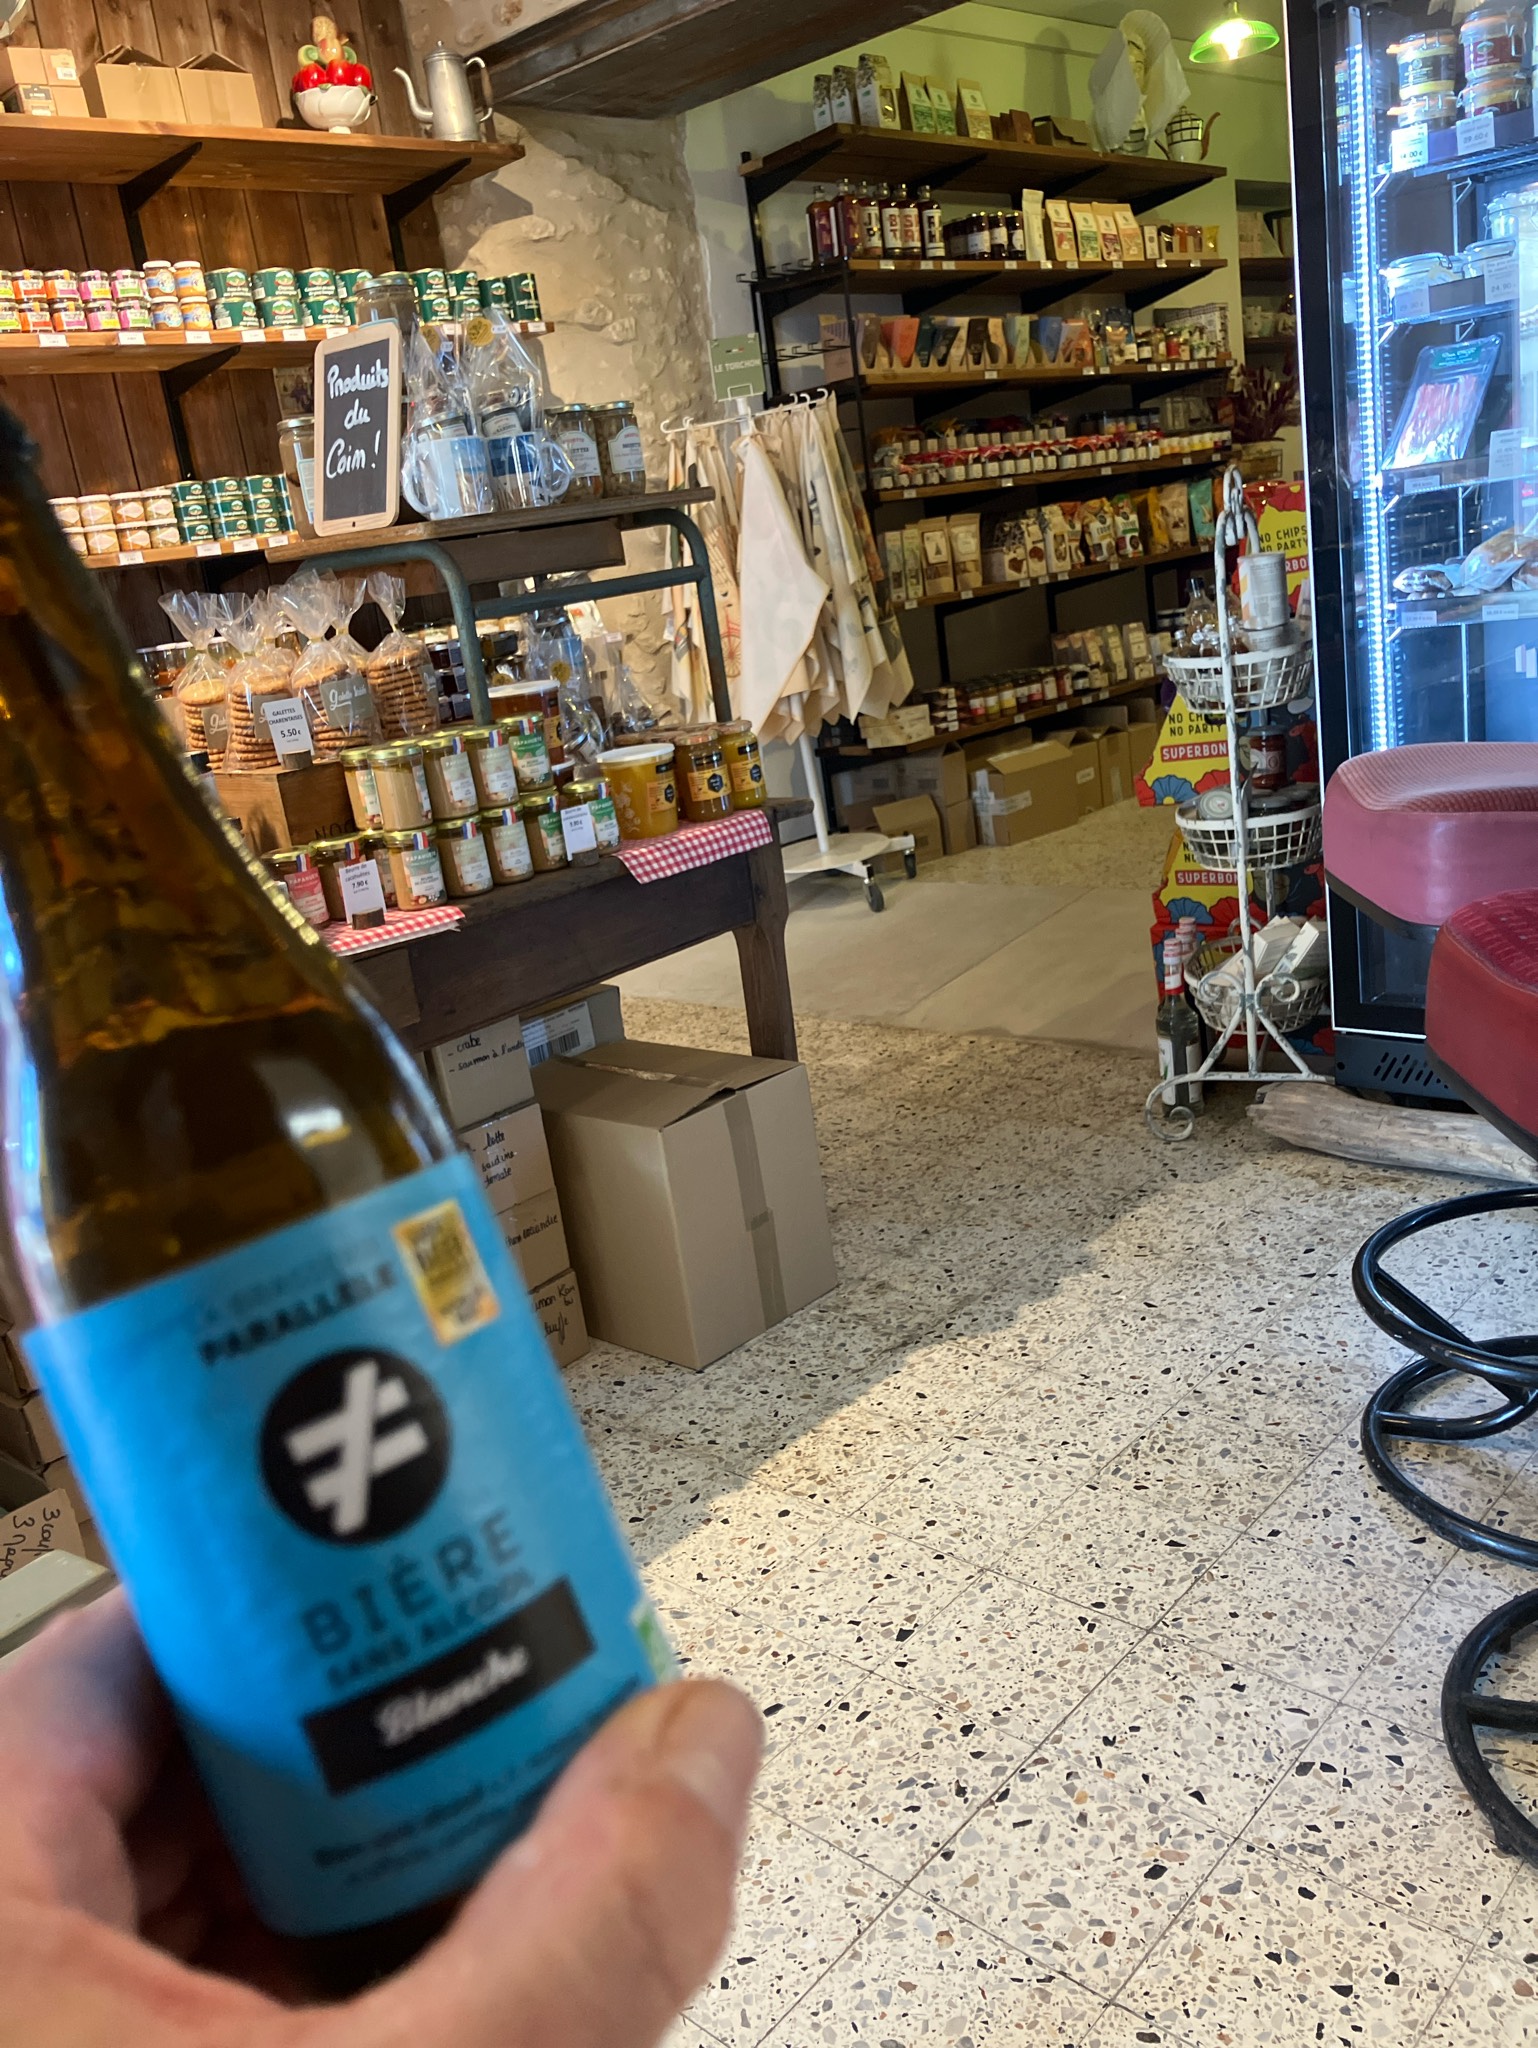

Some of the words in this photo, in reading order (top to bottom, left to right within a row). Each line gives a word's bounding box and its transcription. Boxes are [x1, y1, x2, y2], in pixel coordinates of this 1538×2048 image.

[714, 363, 723, 373] LE
[326, 358, 389, 399] Produits
[343, 398, 371, 430] du
[1276, 525, 1307, 540] CHIPS
[272, 707, 296, 716] GALETTES
[268, 714, 303, 726] CHARENTAISES
[1168, 713, 1183, 725] NO
[280, 728, 297, 738] 5.50
[1169, 726, 1183, 737] NO
[1162, 743, 1227, 760] SUPERBON
[456, 1033, 482, 1053] crabe
[458, 1054, 490, 1071] saumon
[492, 1049, 499, 1059] à
